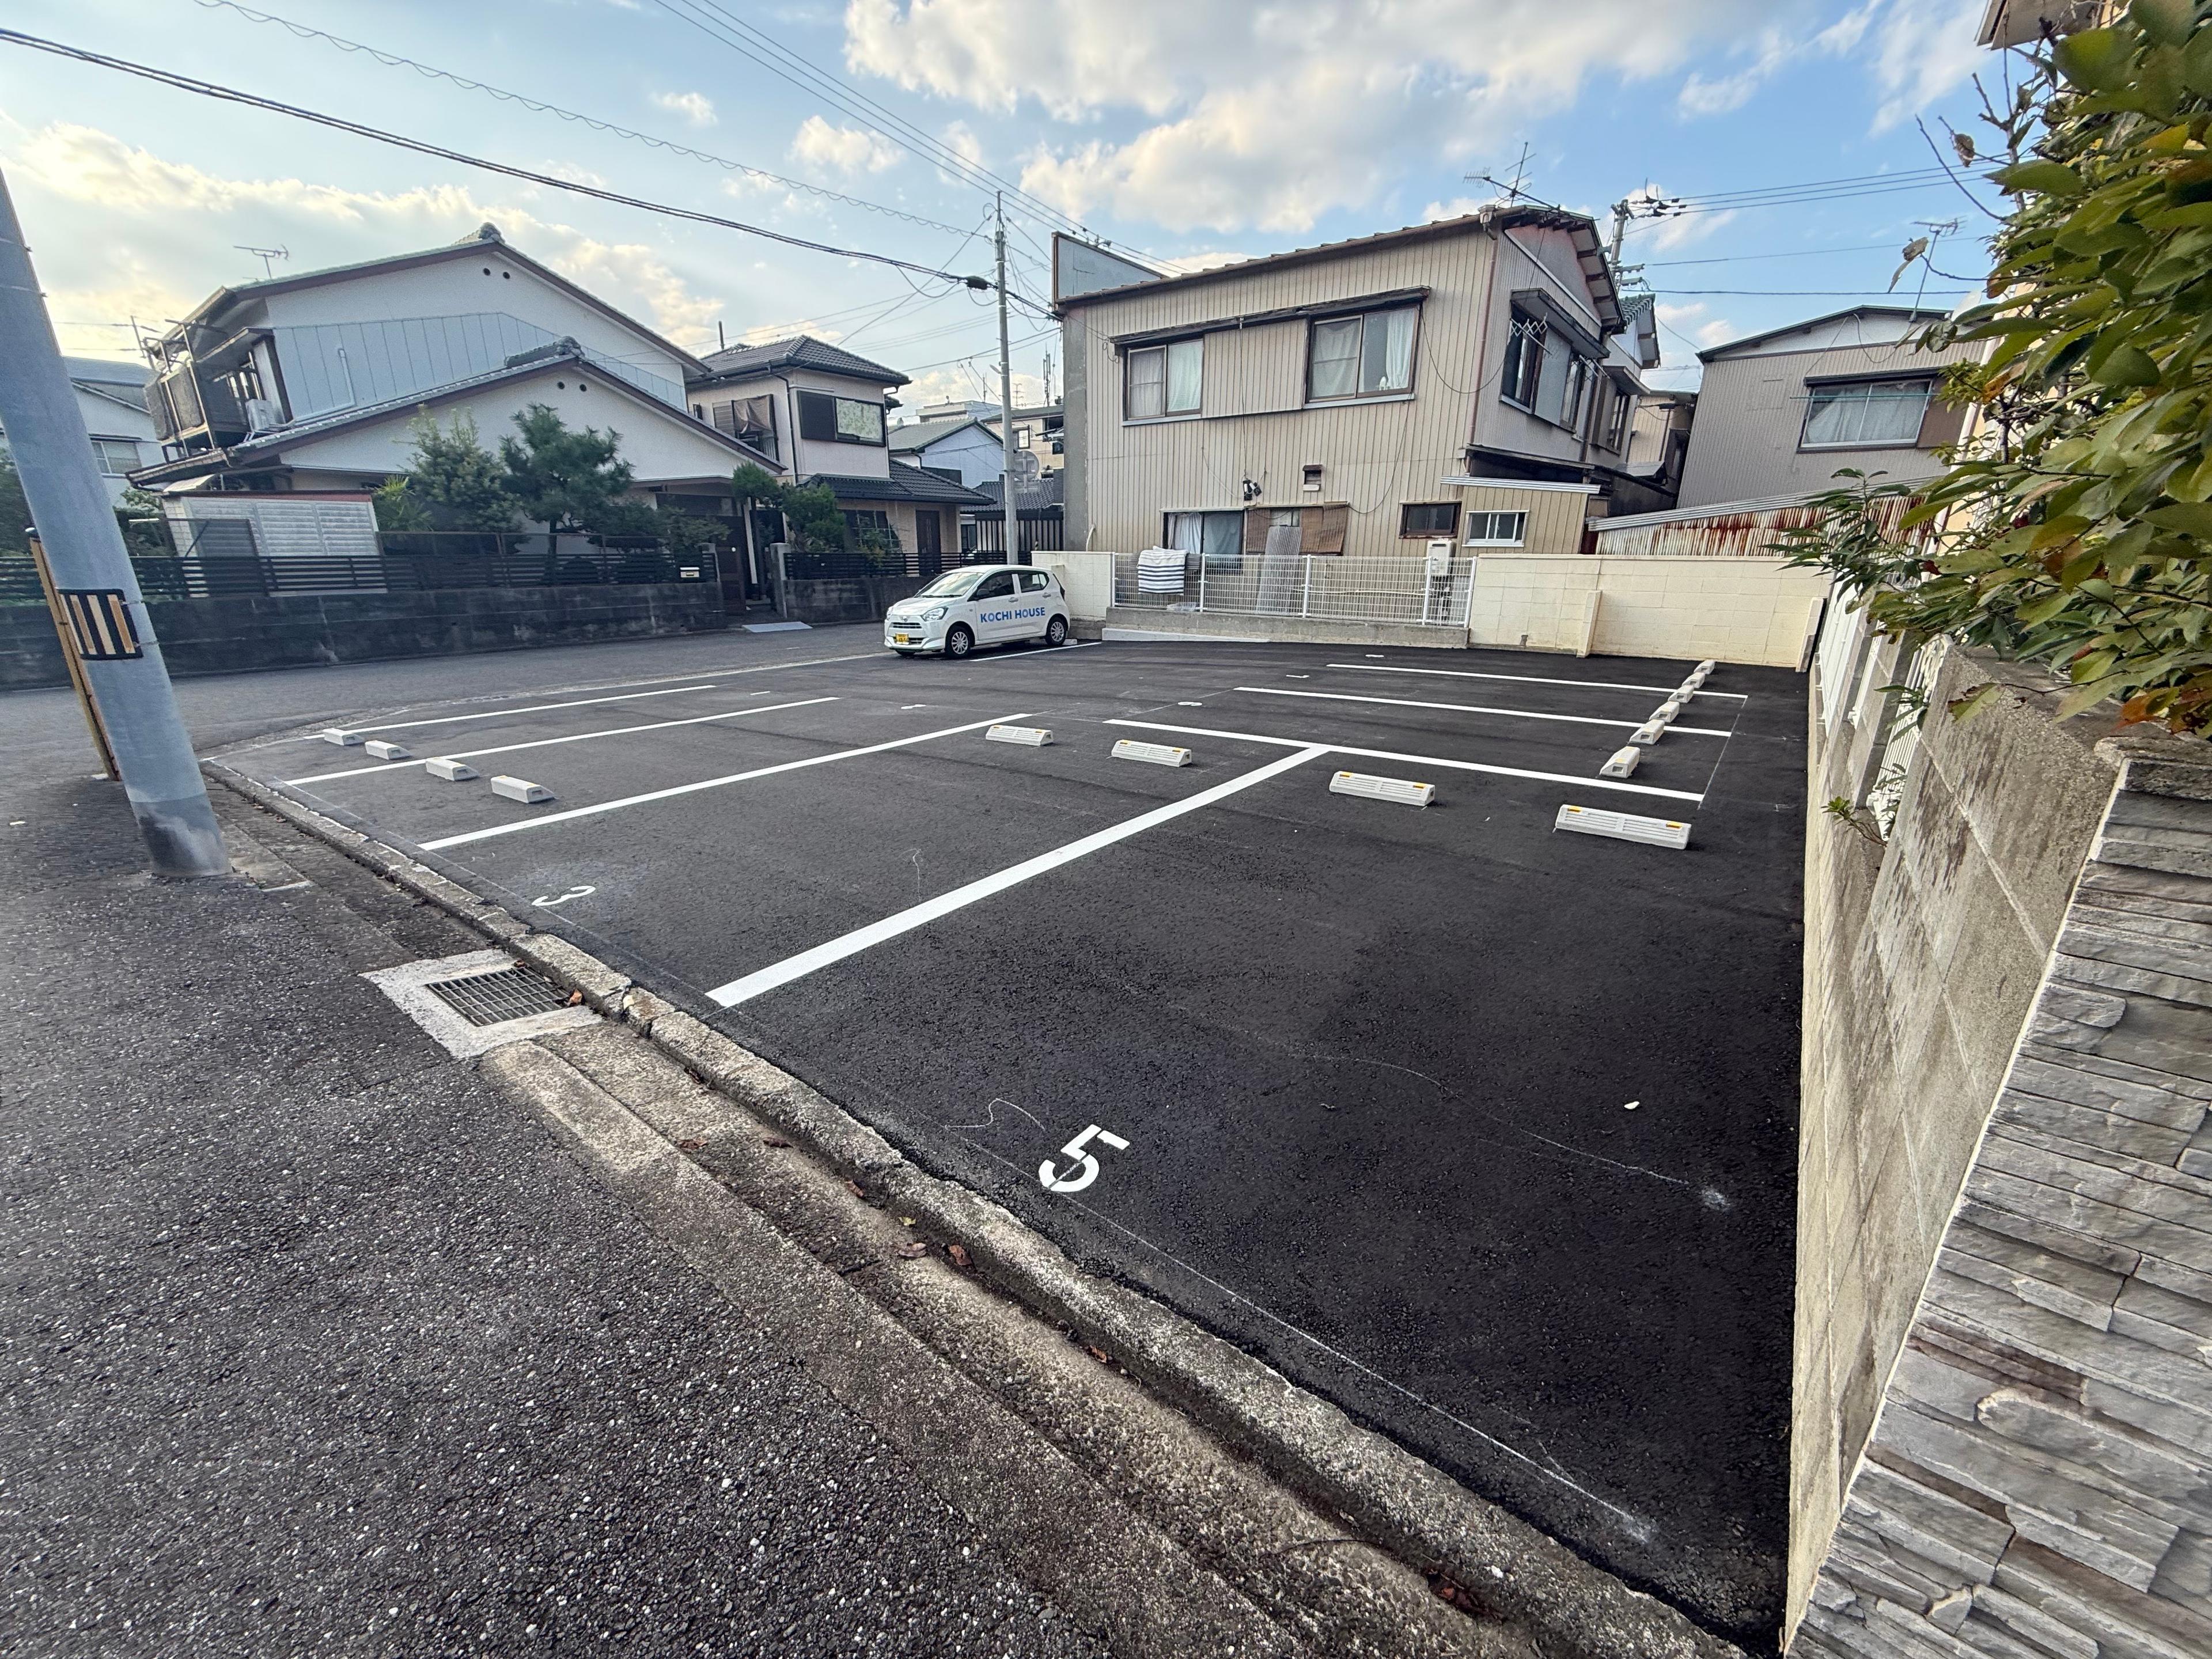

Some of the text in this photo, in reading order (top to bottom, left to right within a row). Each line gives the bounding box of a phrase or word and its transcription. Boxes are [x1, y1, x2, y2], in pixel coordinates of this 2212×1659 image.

[980, 607, 1046, 623] KOCHI HOUSE
[532, 885, 596, 907] 3
[1038, 1124, 1130, 1192] 5
